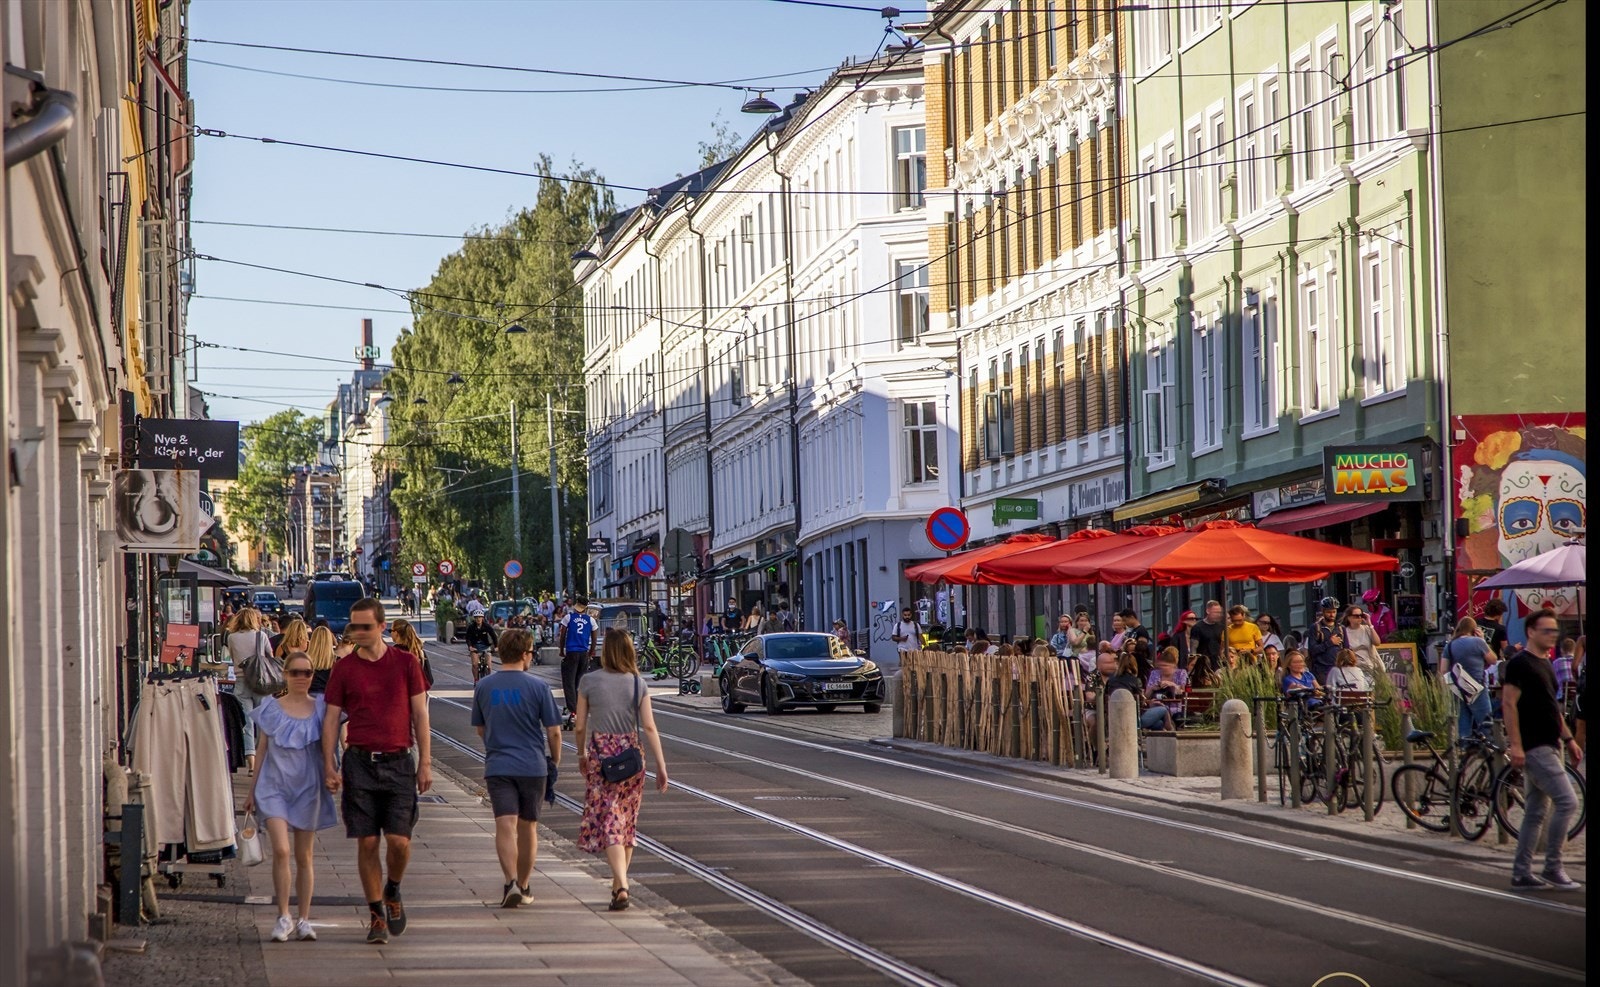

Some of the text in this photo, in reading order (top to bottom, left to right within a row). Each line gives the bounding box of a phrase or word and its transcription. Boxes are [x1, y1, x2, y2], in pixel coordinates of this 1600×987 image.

[154, 433, 188, 446] Nye &
[189, 447, 224, 463] Hoder
[1337, 453, 1407, 470] MUCHO
[1335, 470, 1408, 494] MAS
[1102, 477, 1124, 504] Vintage
[576, 622, 584, 634] 2
[1380, 652, 1395, 662] Try
